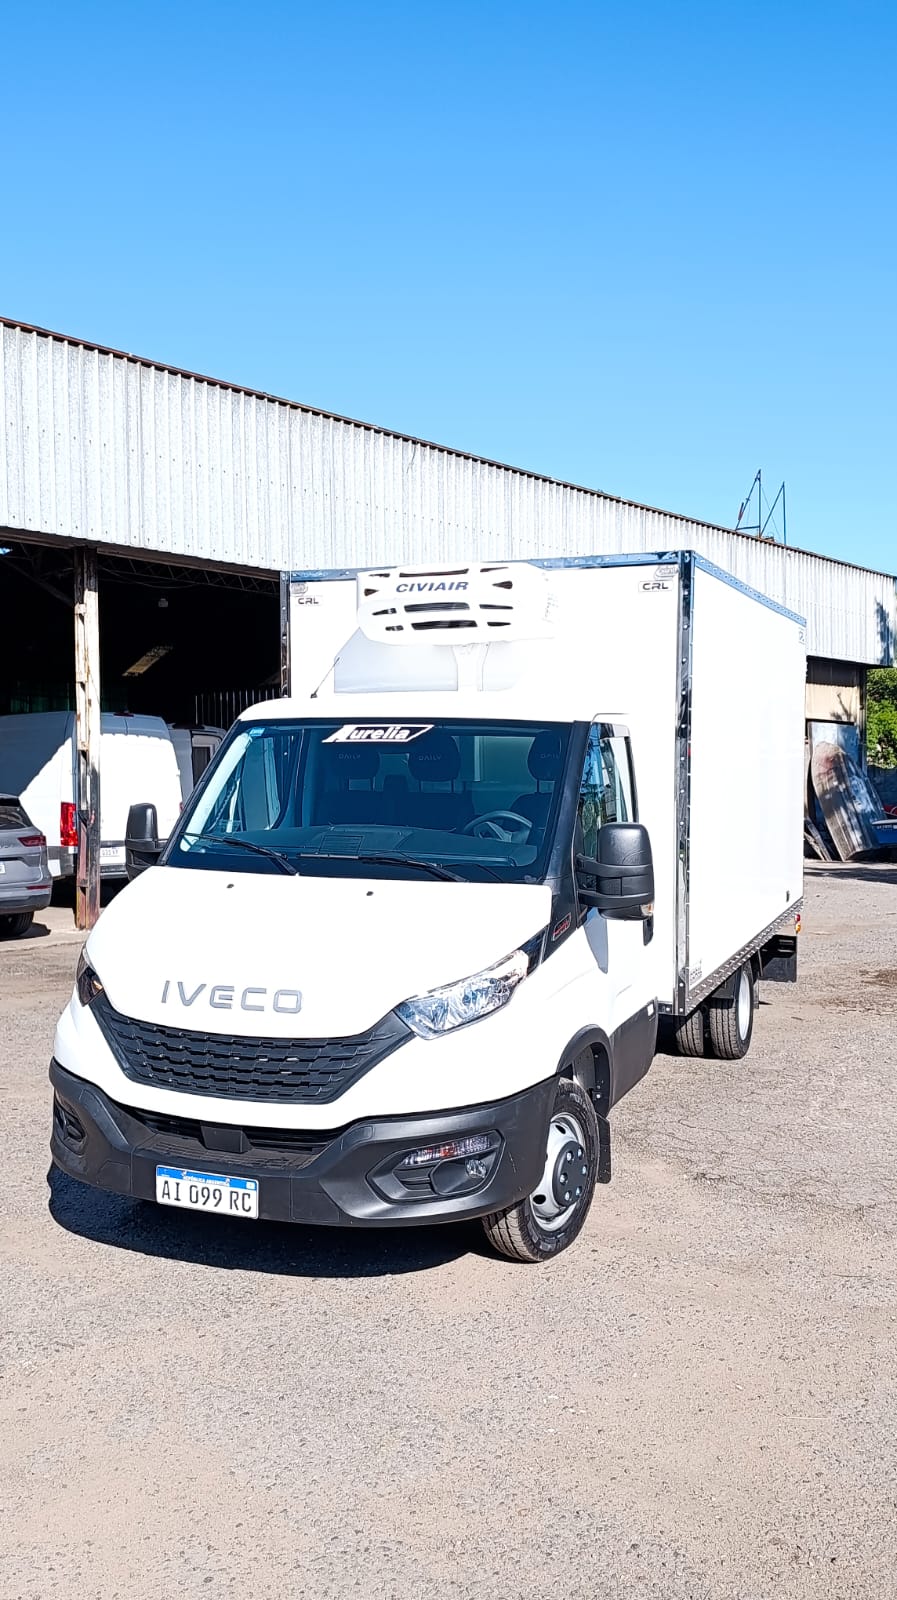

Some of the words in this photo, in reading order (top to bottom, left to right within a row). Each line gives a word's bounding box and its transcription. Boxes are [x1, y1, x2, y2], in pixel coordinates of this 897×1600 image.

[396, 581, 469, 593] CIVIAIR
[642, 582, 669, 591] CRL
[297, 596, 319, 605] CRL
[332, 724, 410, 742] Aurelia
[161, 980, 303, 1014] IVECO
[162, 1180, 181, 1202] AI
[189, 1184, 222, 1208] 099
[230, 1190, 252, 1213] RC
